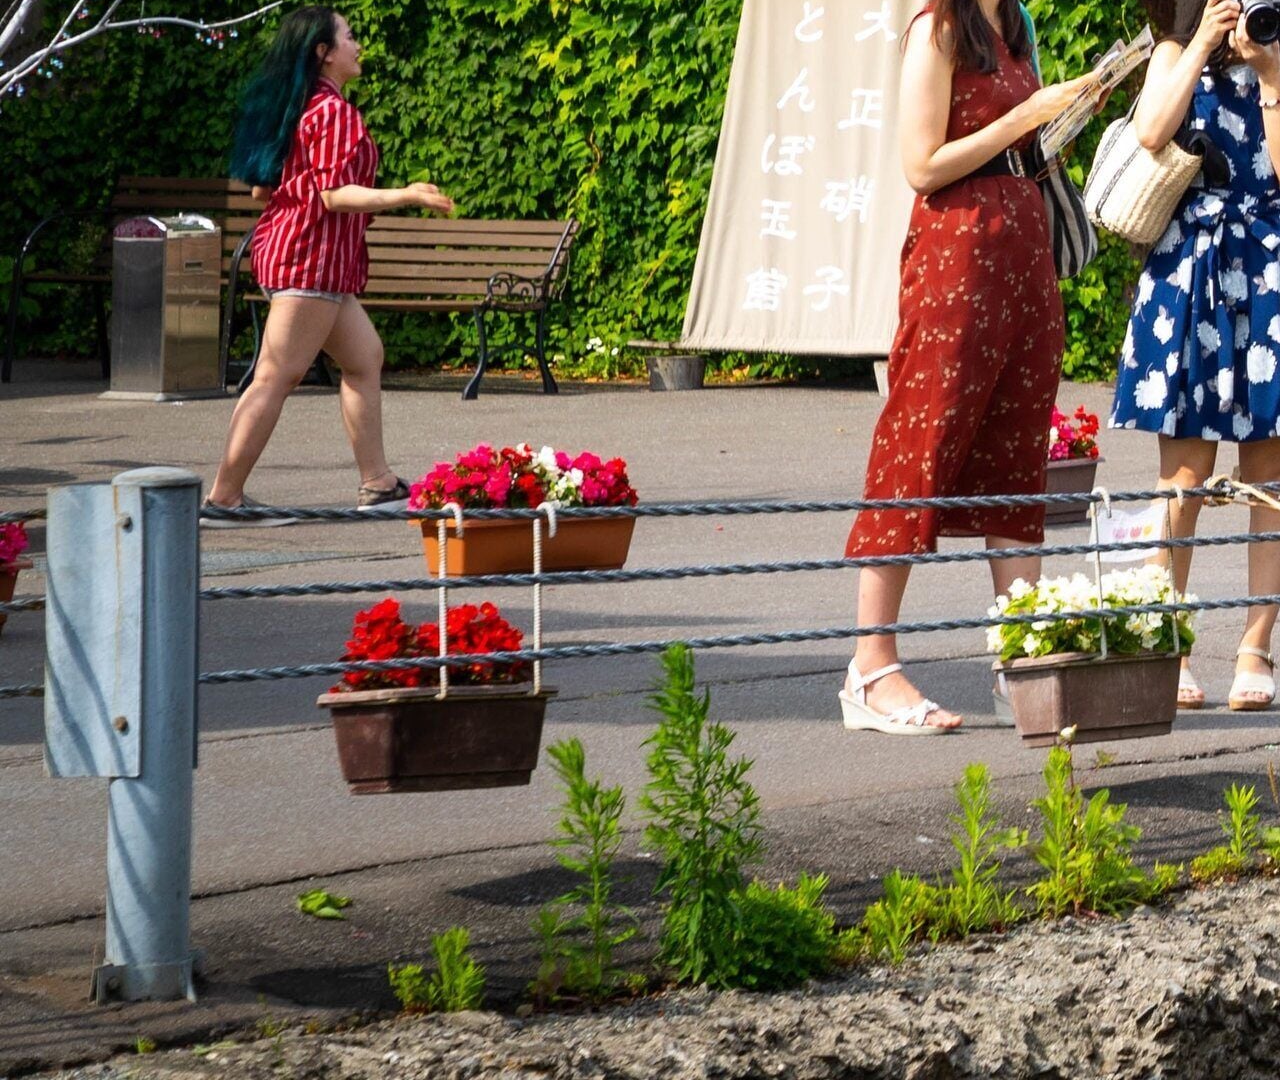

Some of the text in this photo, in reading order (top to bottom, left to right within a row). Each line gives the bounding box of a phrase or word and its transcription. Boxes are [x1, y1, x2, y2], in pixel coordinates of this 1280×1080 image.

[741, 1, 827, 312] とんぼ玉館
[800, 0, 899, 313] 大正硝子
